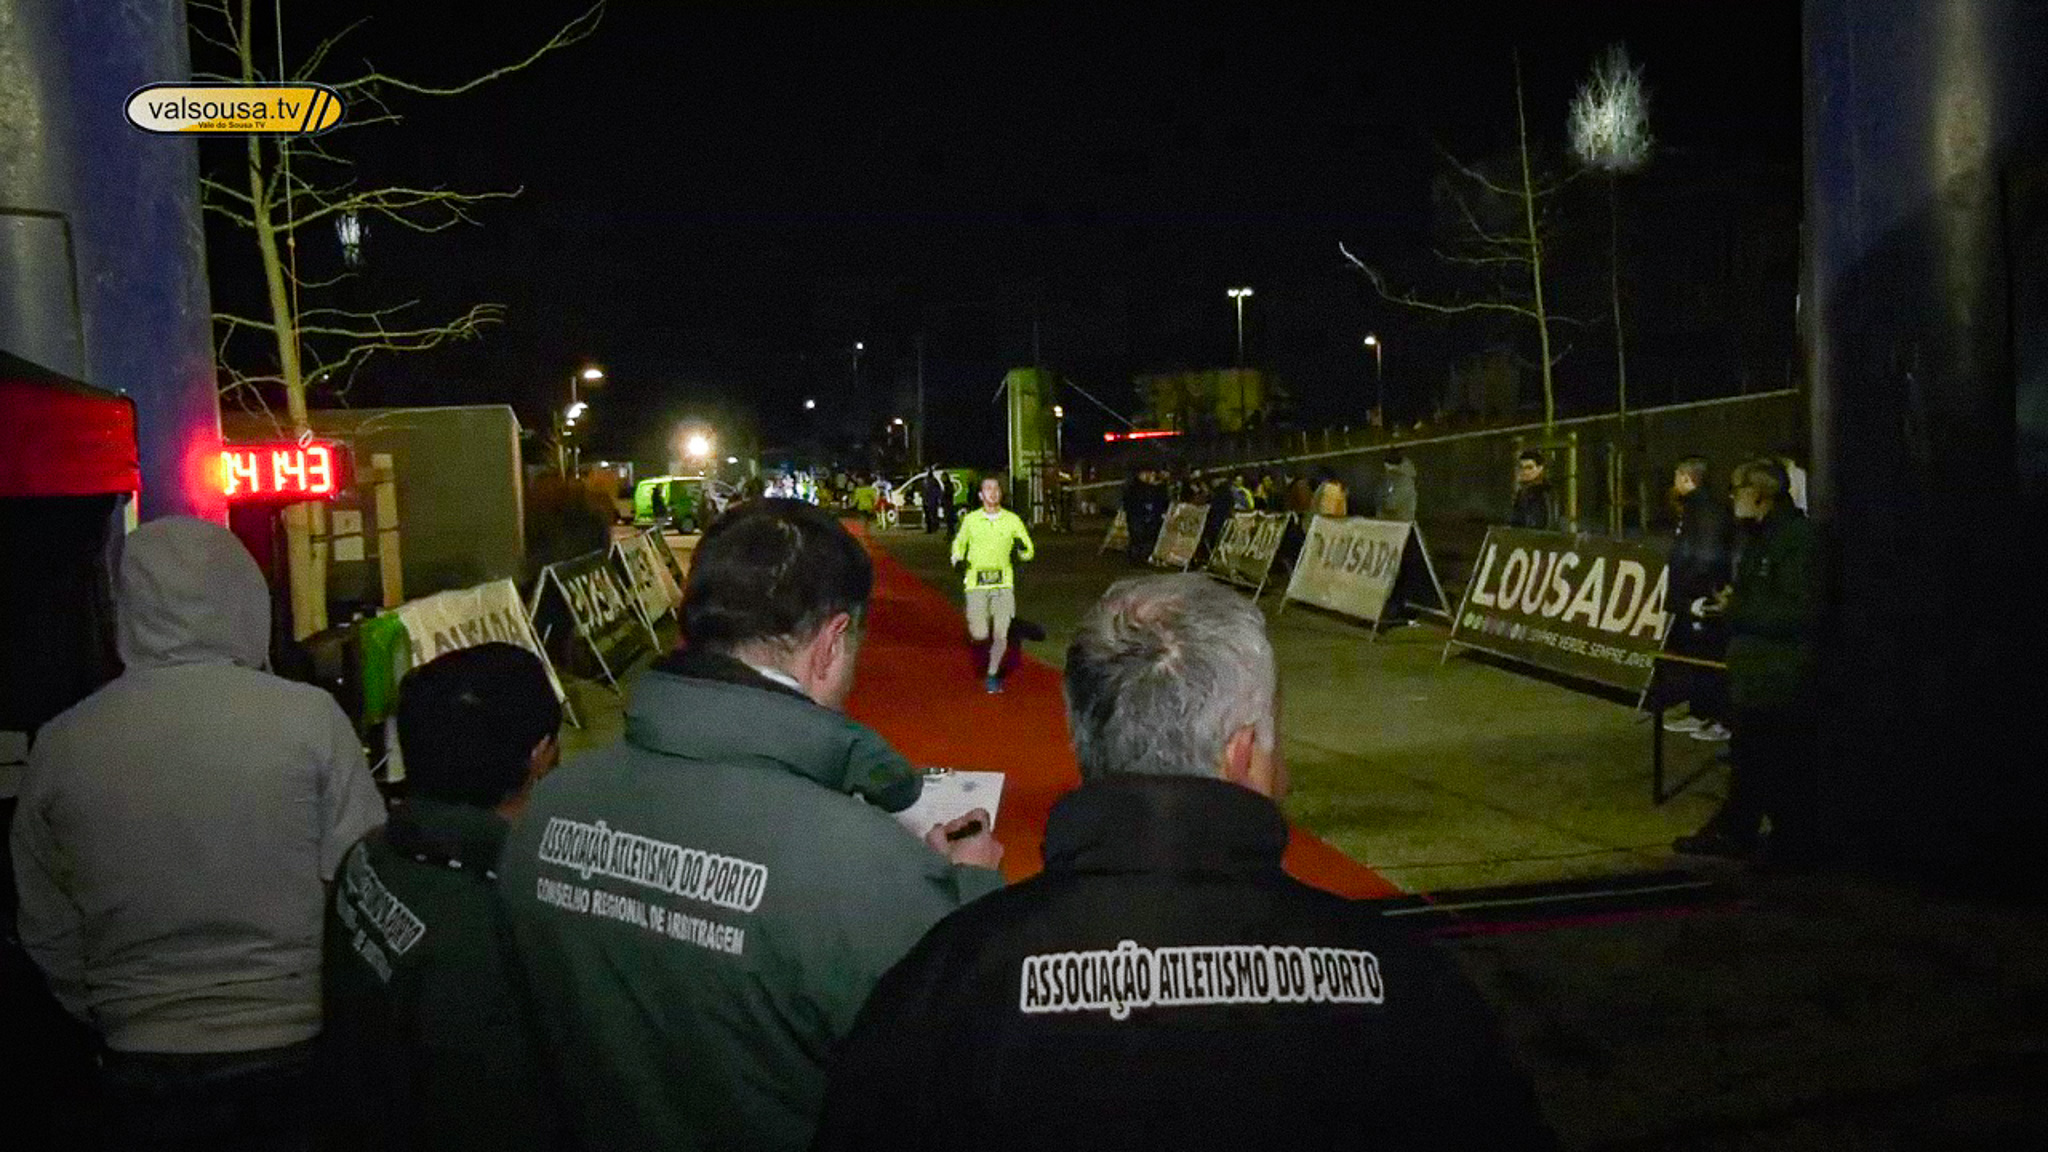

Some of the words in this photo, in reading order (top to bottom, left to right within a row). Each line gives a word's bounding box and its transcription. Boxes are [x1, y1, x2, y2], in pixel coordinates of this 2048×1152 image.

[1471, 543, 1670, 640] LOUSADA
[611, 832, 680, 892] ATLETISMO
[679, 848, 704, 898] DO
[703, 855, 769, 912] PORTO
[648, 904, 666, 933] DE
[1024, 942, 1152, 1018] ASSOCIAÇÃO
[1157, 948, 1270, 1003] ATLETISMO
[1274, 949, 1306, 1001] DO
[1312, 950, 1383, 1003] PORTO
